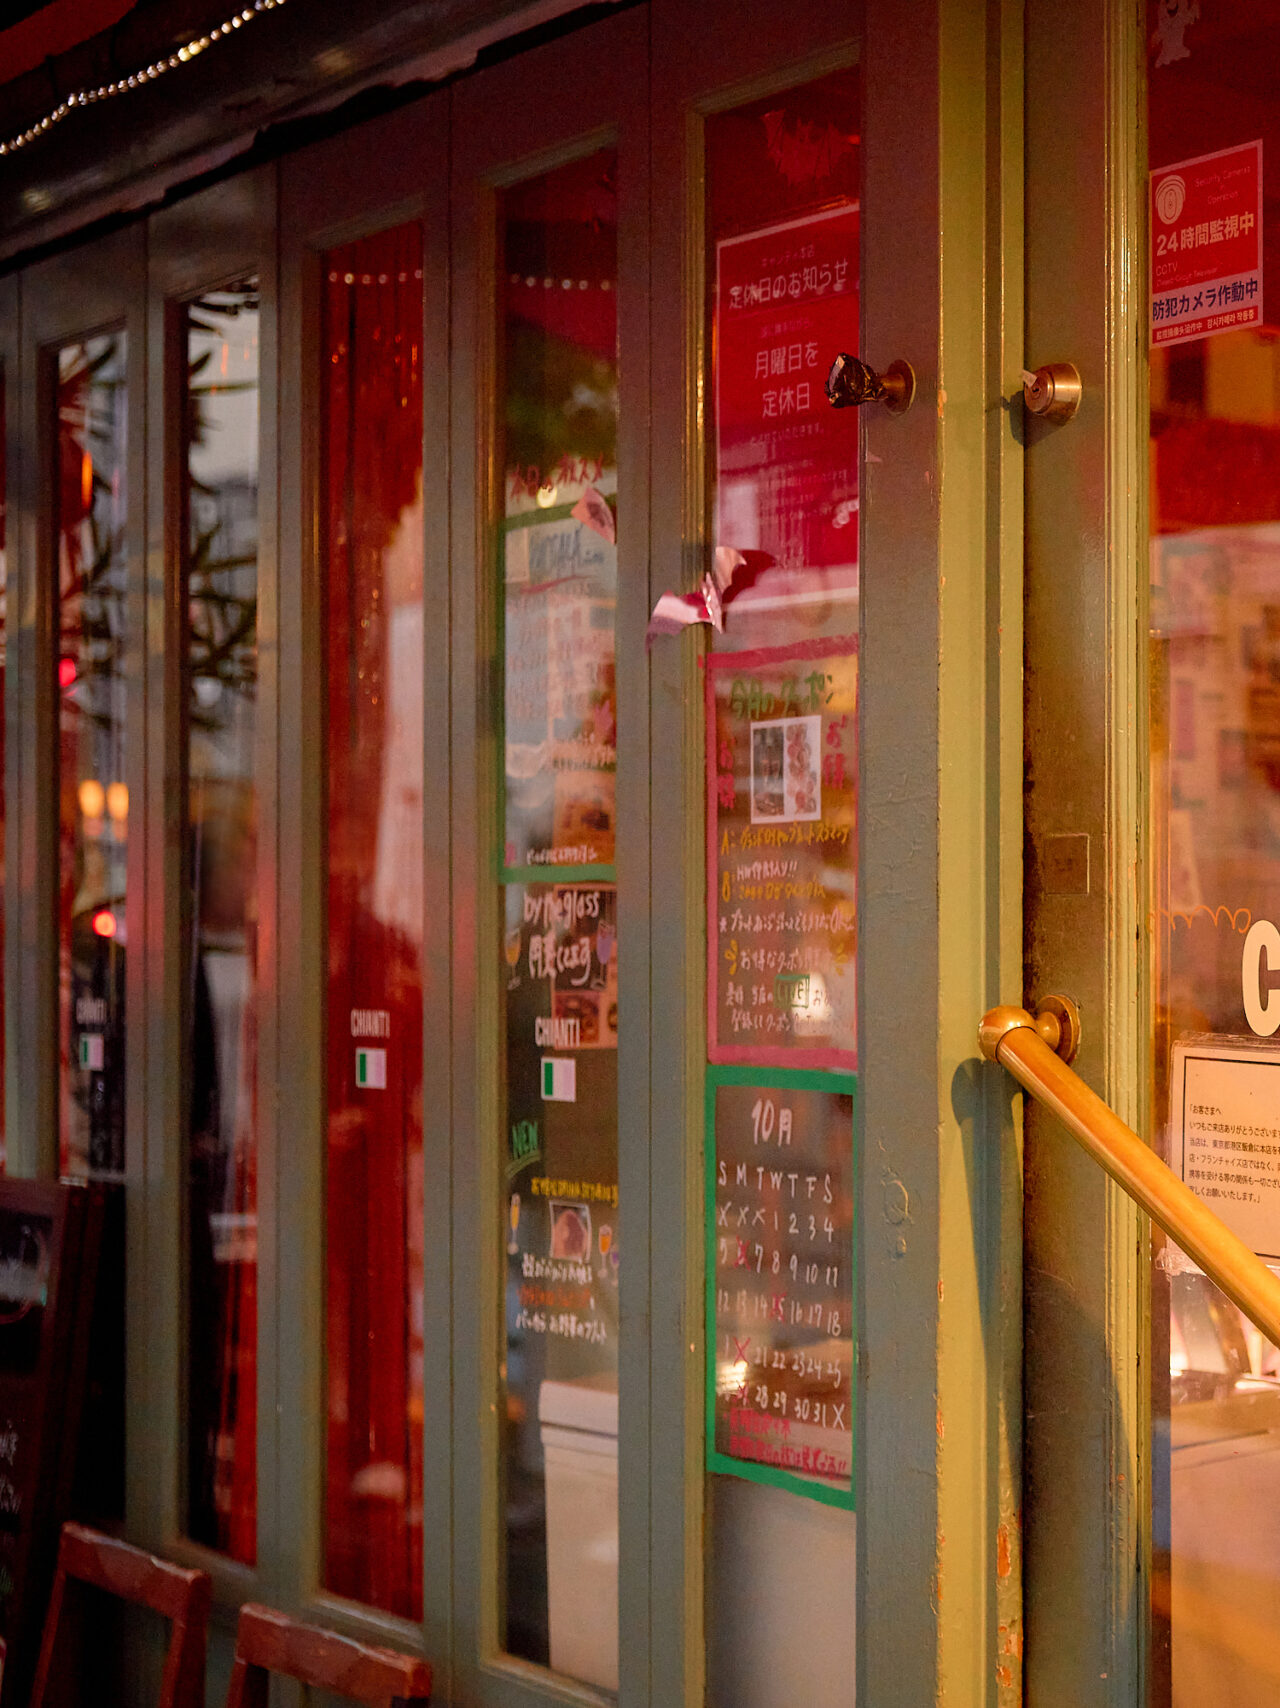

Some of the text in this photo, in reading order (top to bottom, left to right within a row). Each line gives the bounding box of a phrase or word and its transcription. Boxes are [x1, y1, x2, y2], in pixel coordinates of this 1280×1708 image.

[1156, 211, 1255, 257] 24時間監視中
[728, 258, 848, 310] 定休日のお知らせ
[1152, 277, 1258, 321] 防犯カメラ作動中
[755, 342, 819, 380] 月曜日を
[762, 382, 811, 419] 定休日
[535, 1016, 581, 1048] CHIANTI
[751, 1099, 793, 1147] 10月
[718, 1160, 833, 1204] S M T W T F S
[774, 1210, 834, 1243] 1 2 3 4
[755, 1243, 763, 1274] 7
[771, 1249, 780, 1275] 8
[789, 1253, 798, 1281] 9
[806, 1263, 818, 1285] 10
[826, 1266, 838, 1288] 11
[755, 1294, 768, 1318] 14
[790, 1299, 803, 1325] 16
[808, 1303, 822, 1328] 17
[827, 1310, 841, 1337] 18
[755, 1346, 768, 1369] 21
[772, 1350, 786, 1370] 22
[791, 1351, 805, 1378] 23
[807, 1357, 822, 1380] 24
[826, 1358, 841, 1388] 25
[755, 1384, 769, 1409] 28
[773, 1390, 787, 1416] 29
[794, 1397, 810, 1420] 30
[814, 1402, 826, 1428] 31
